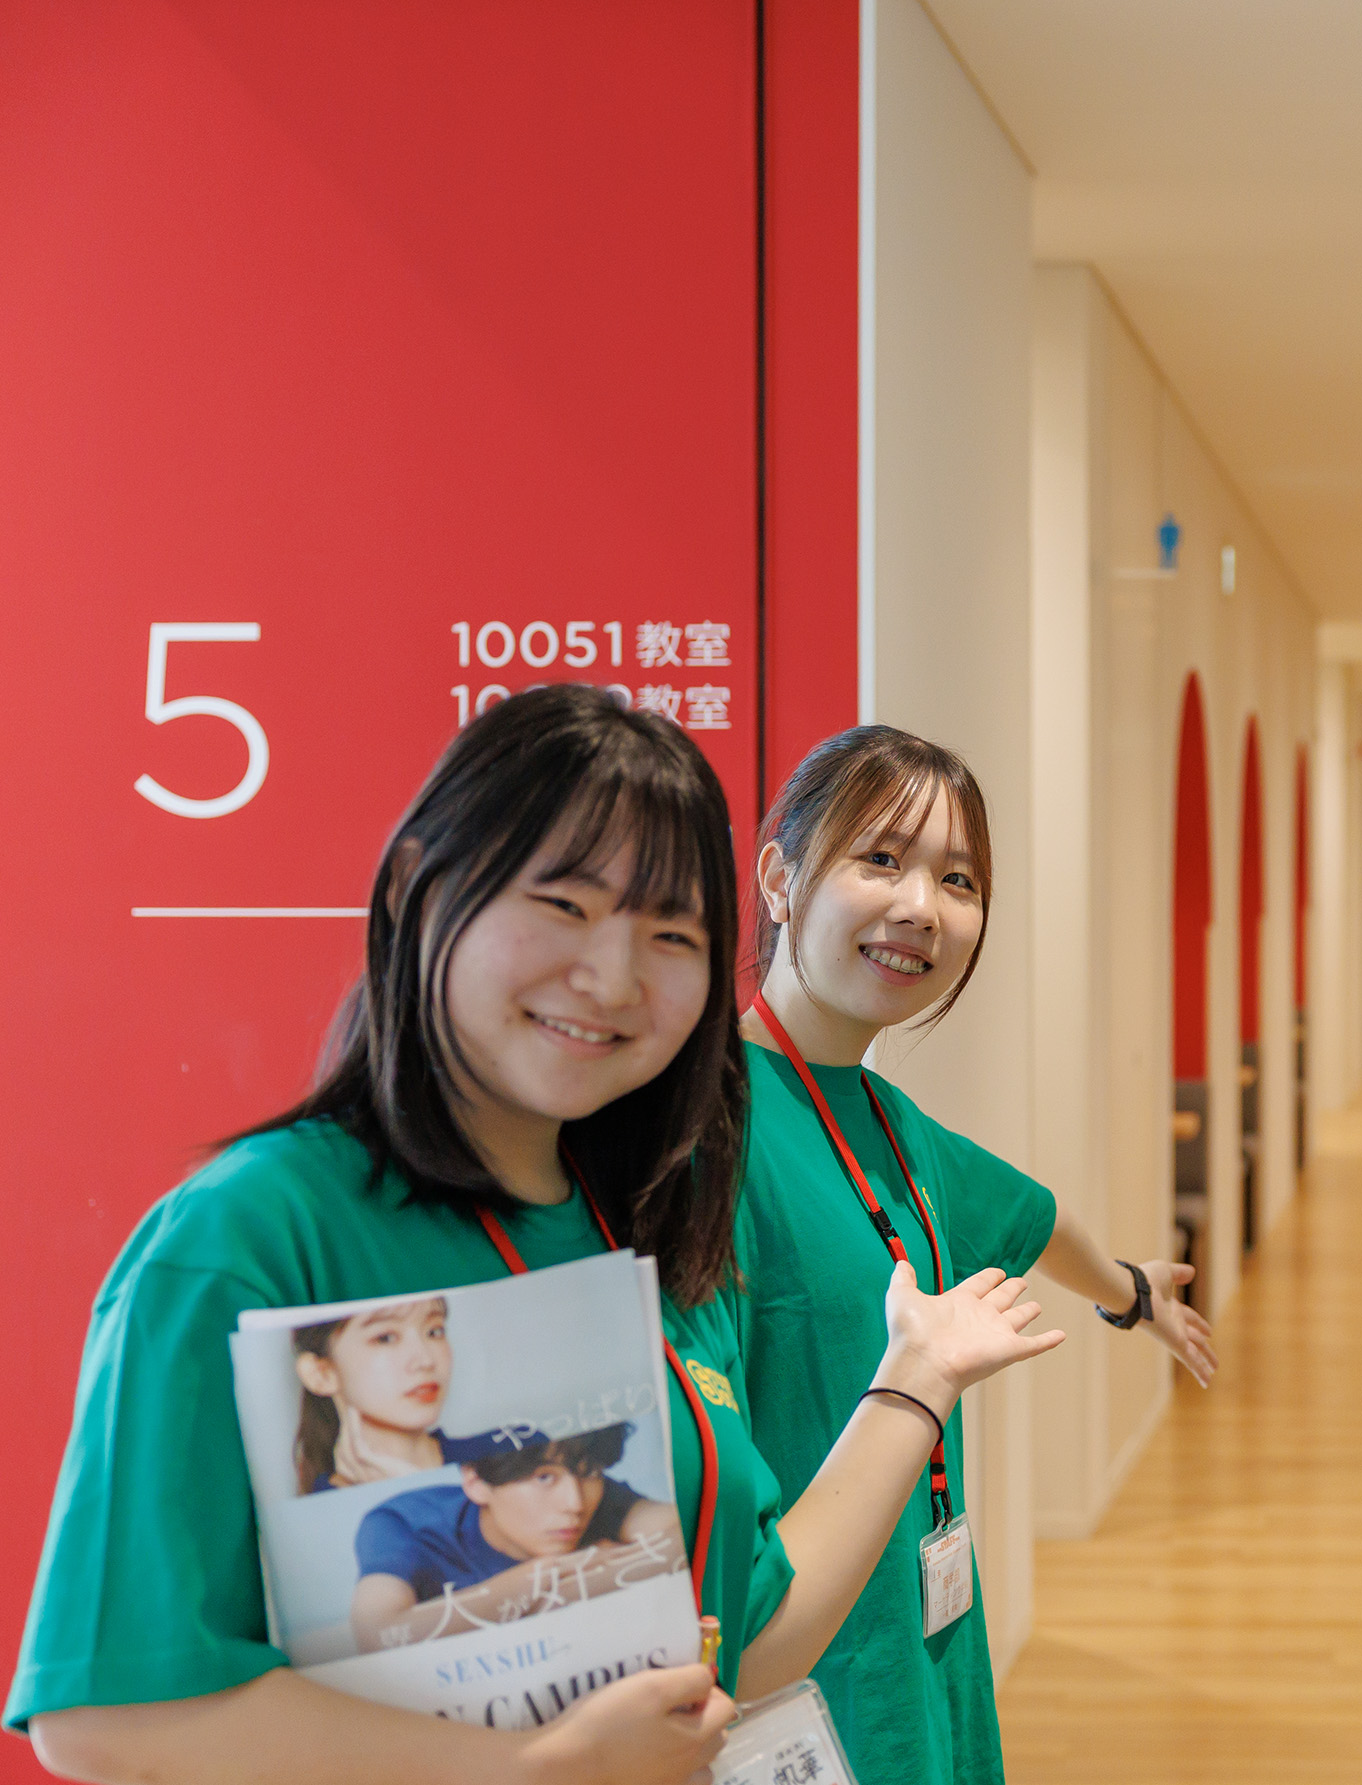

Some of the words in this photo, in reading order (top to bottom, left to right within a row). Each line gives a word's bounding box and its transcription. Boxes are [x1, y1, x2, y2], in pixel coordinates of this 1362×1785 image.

[451, 620, 731, 668] 10051教室
[134, 622, 269, 819] 5
[451, 683, 731, 730] 10教室
[491, 1382, 658, 1451] やっぱり
